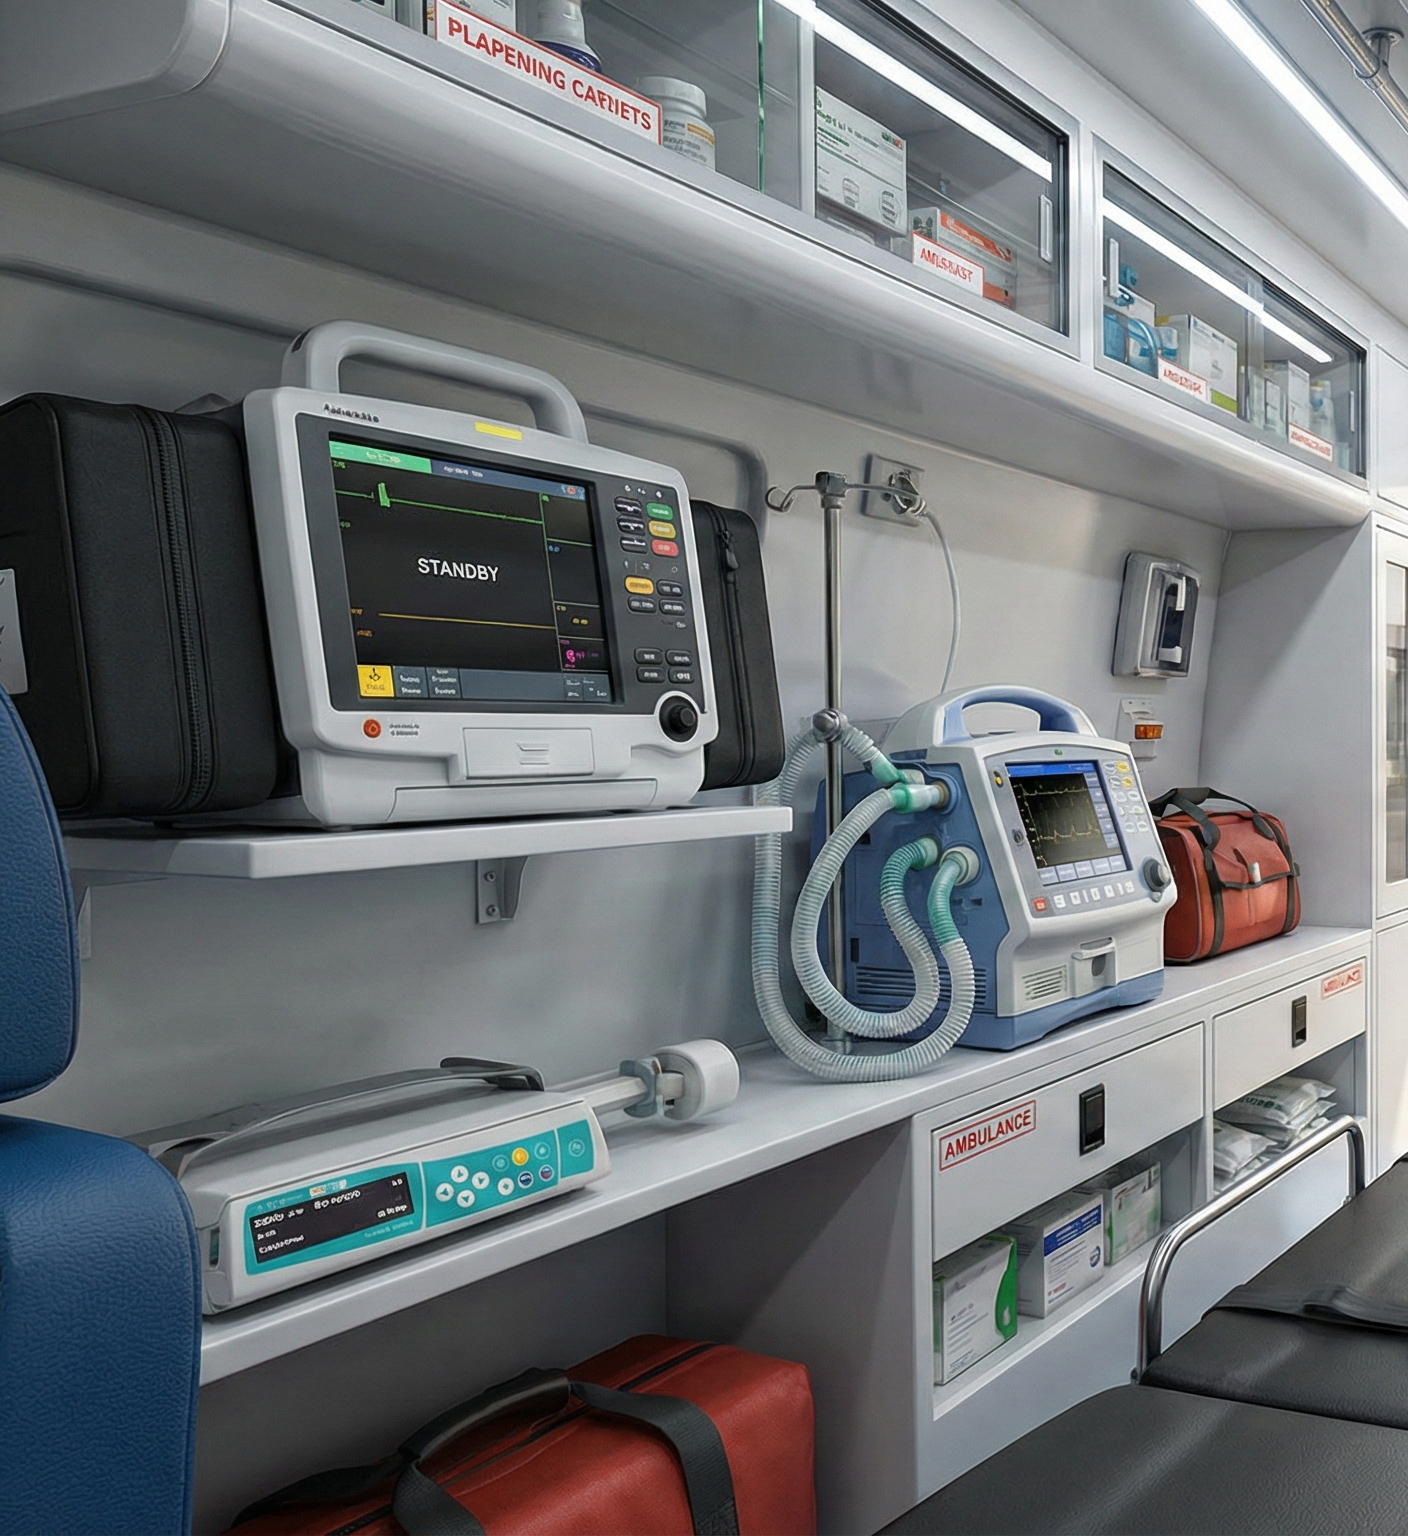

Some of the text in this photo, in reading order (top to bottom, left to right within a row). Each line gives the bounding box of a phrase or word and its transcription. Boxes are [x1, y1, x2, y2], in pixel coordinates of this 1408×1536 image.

[448, 16, 566, 91] PLAPENING
[417, 557, 499, 582] STANDBY
[944, 1108, 1032, 1161] AMBULANCE
